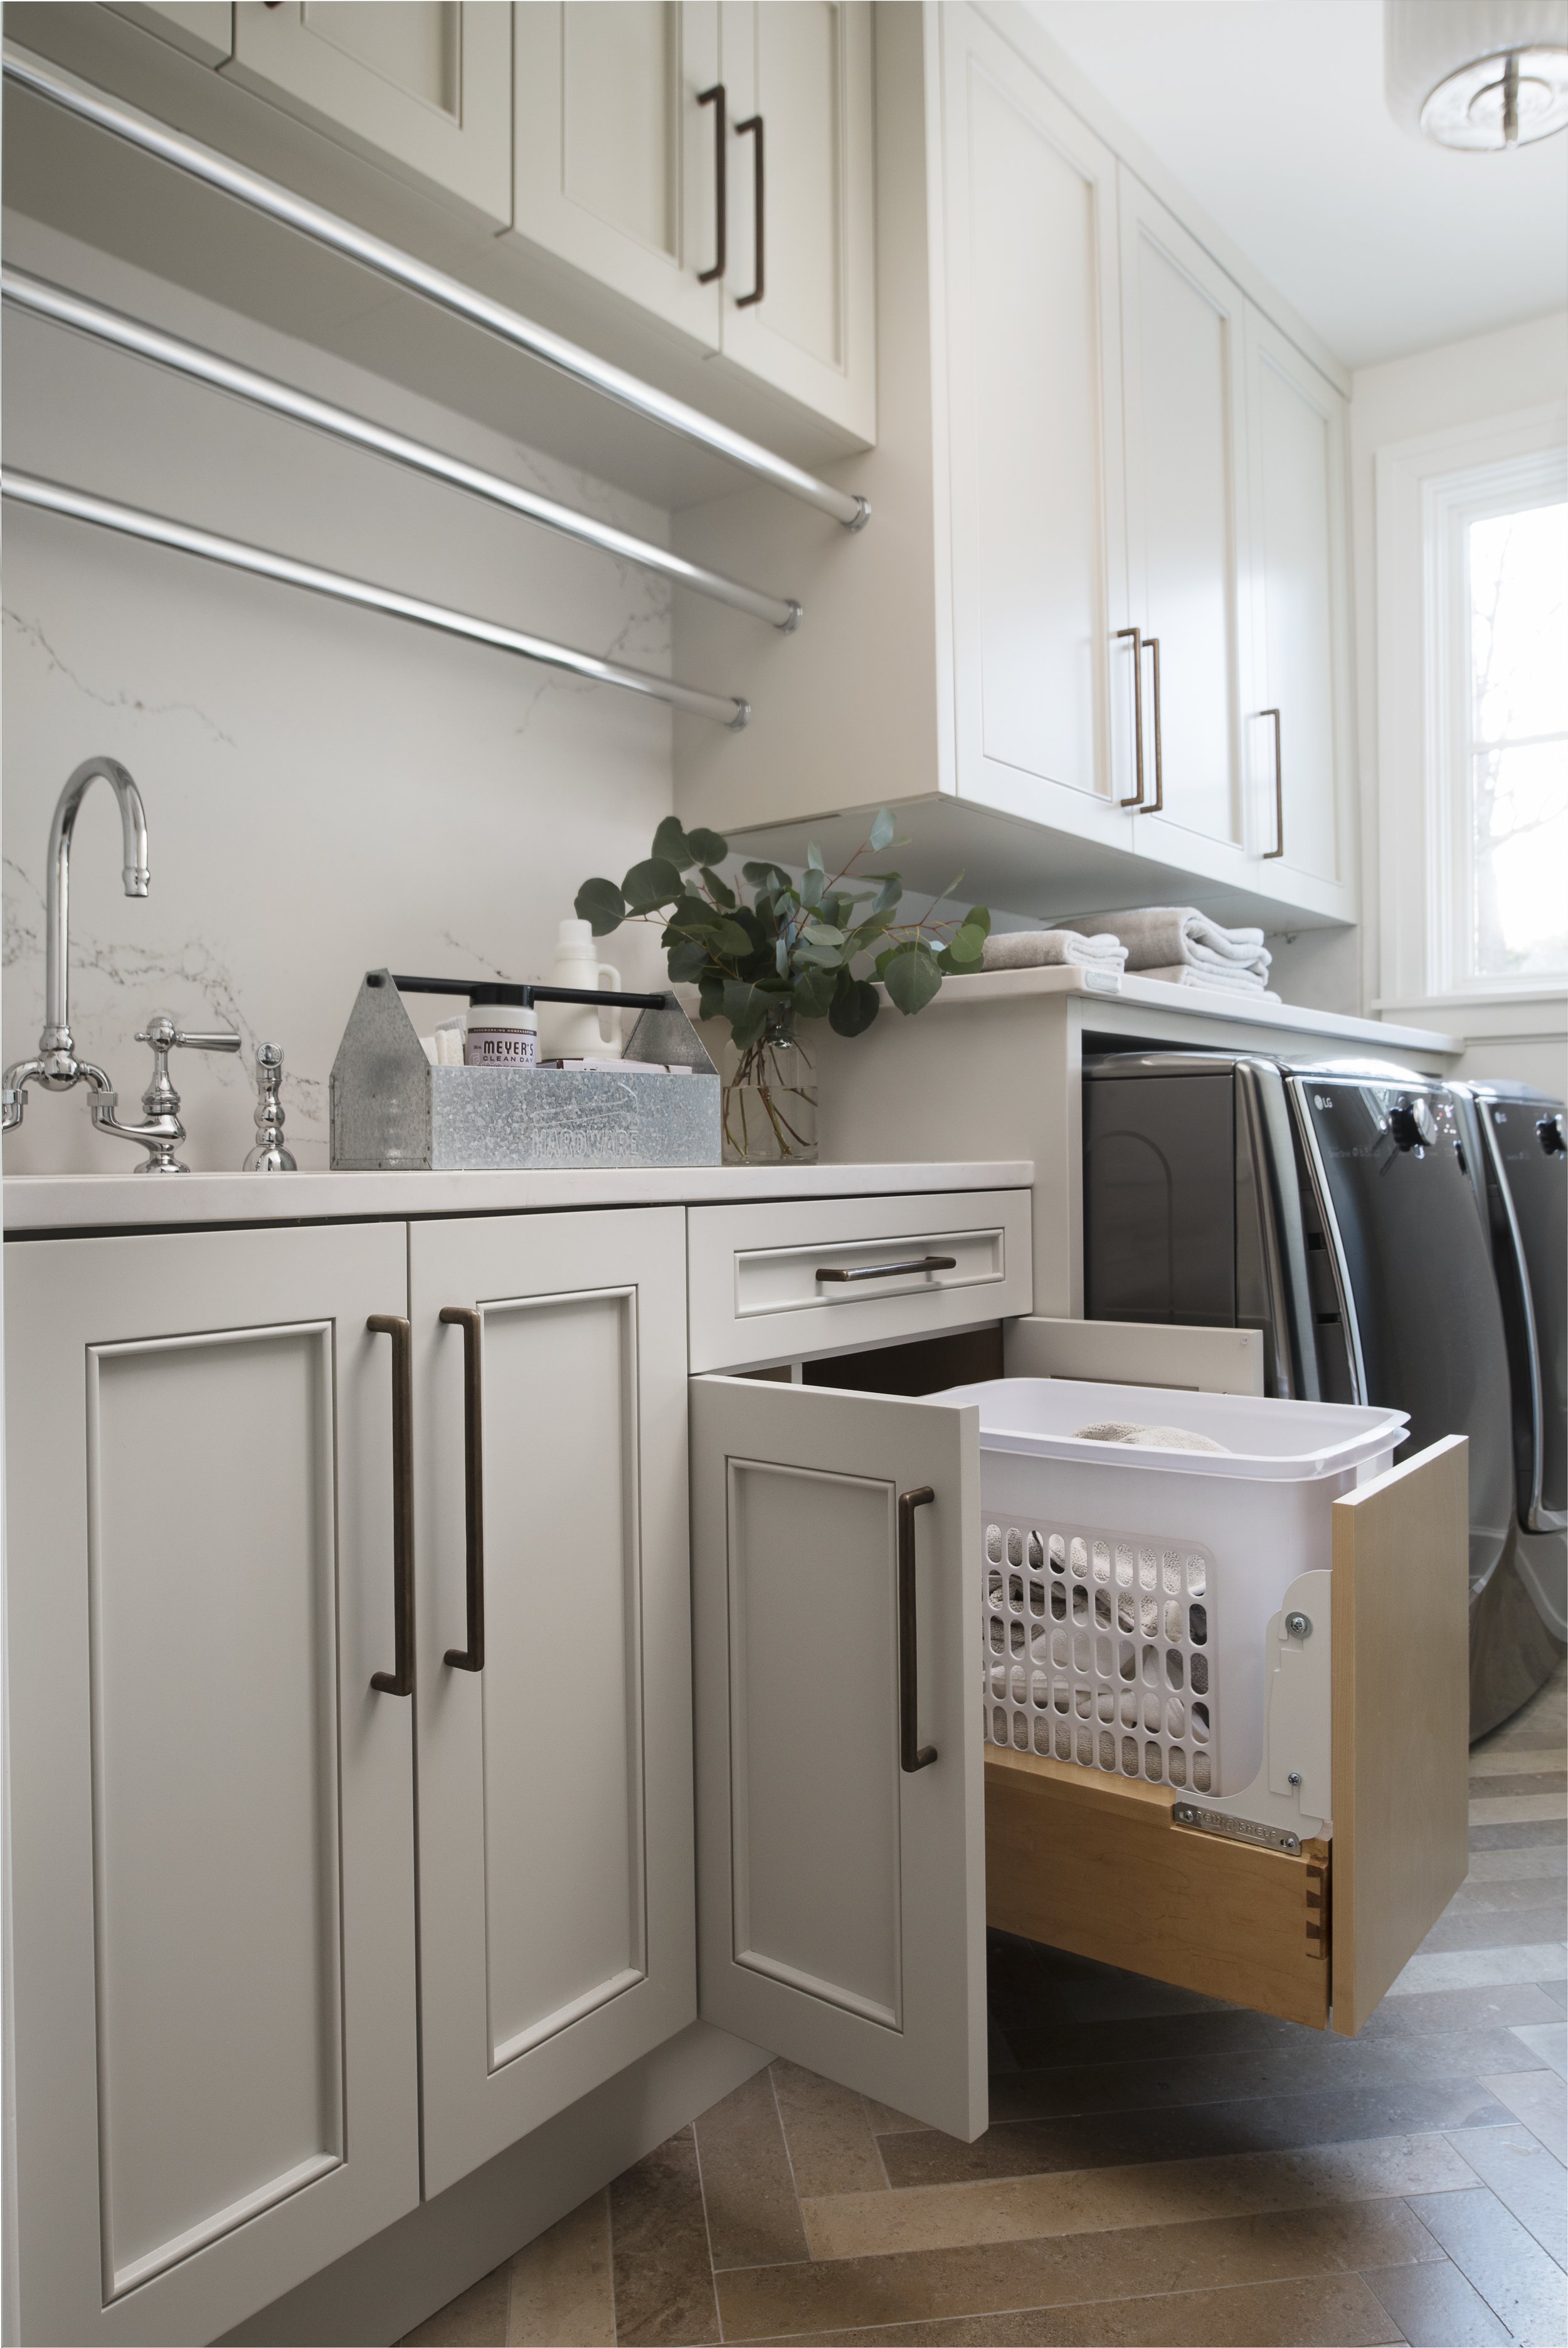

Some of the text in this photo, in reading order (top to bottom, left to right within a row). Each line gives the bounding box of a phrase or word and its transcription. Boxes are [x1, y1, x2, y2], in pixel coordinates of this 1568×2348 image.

[483, 1040, 533, 1056] MEYER'S
[1322, 1097, 1333, 1108] LG
[532, 1128, 638, 1157] HARDWARE
[1238, 1822, 1276, 1838] SHELF
